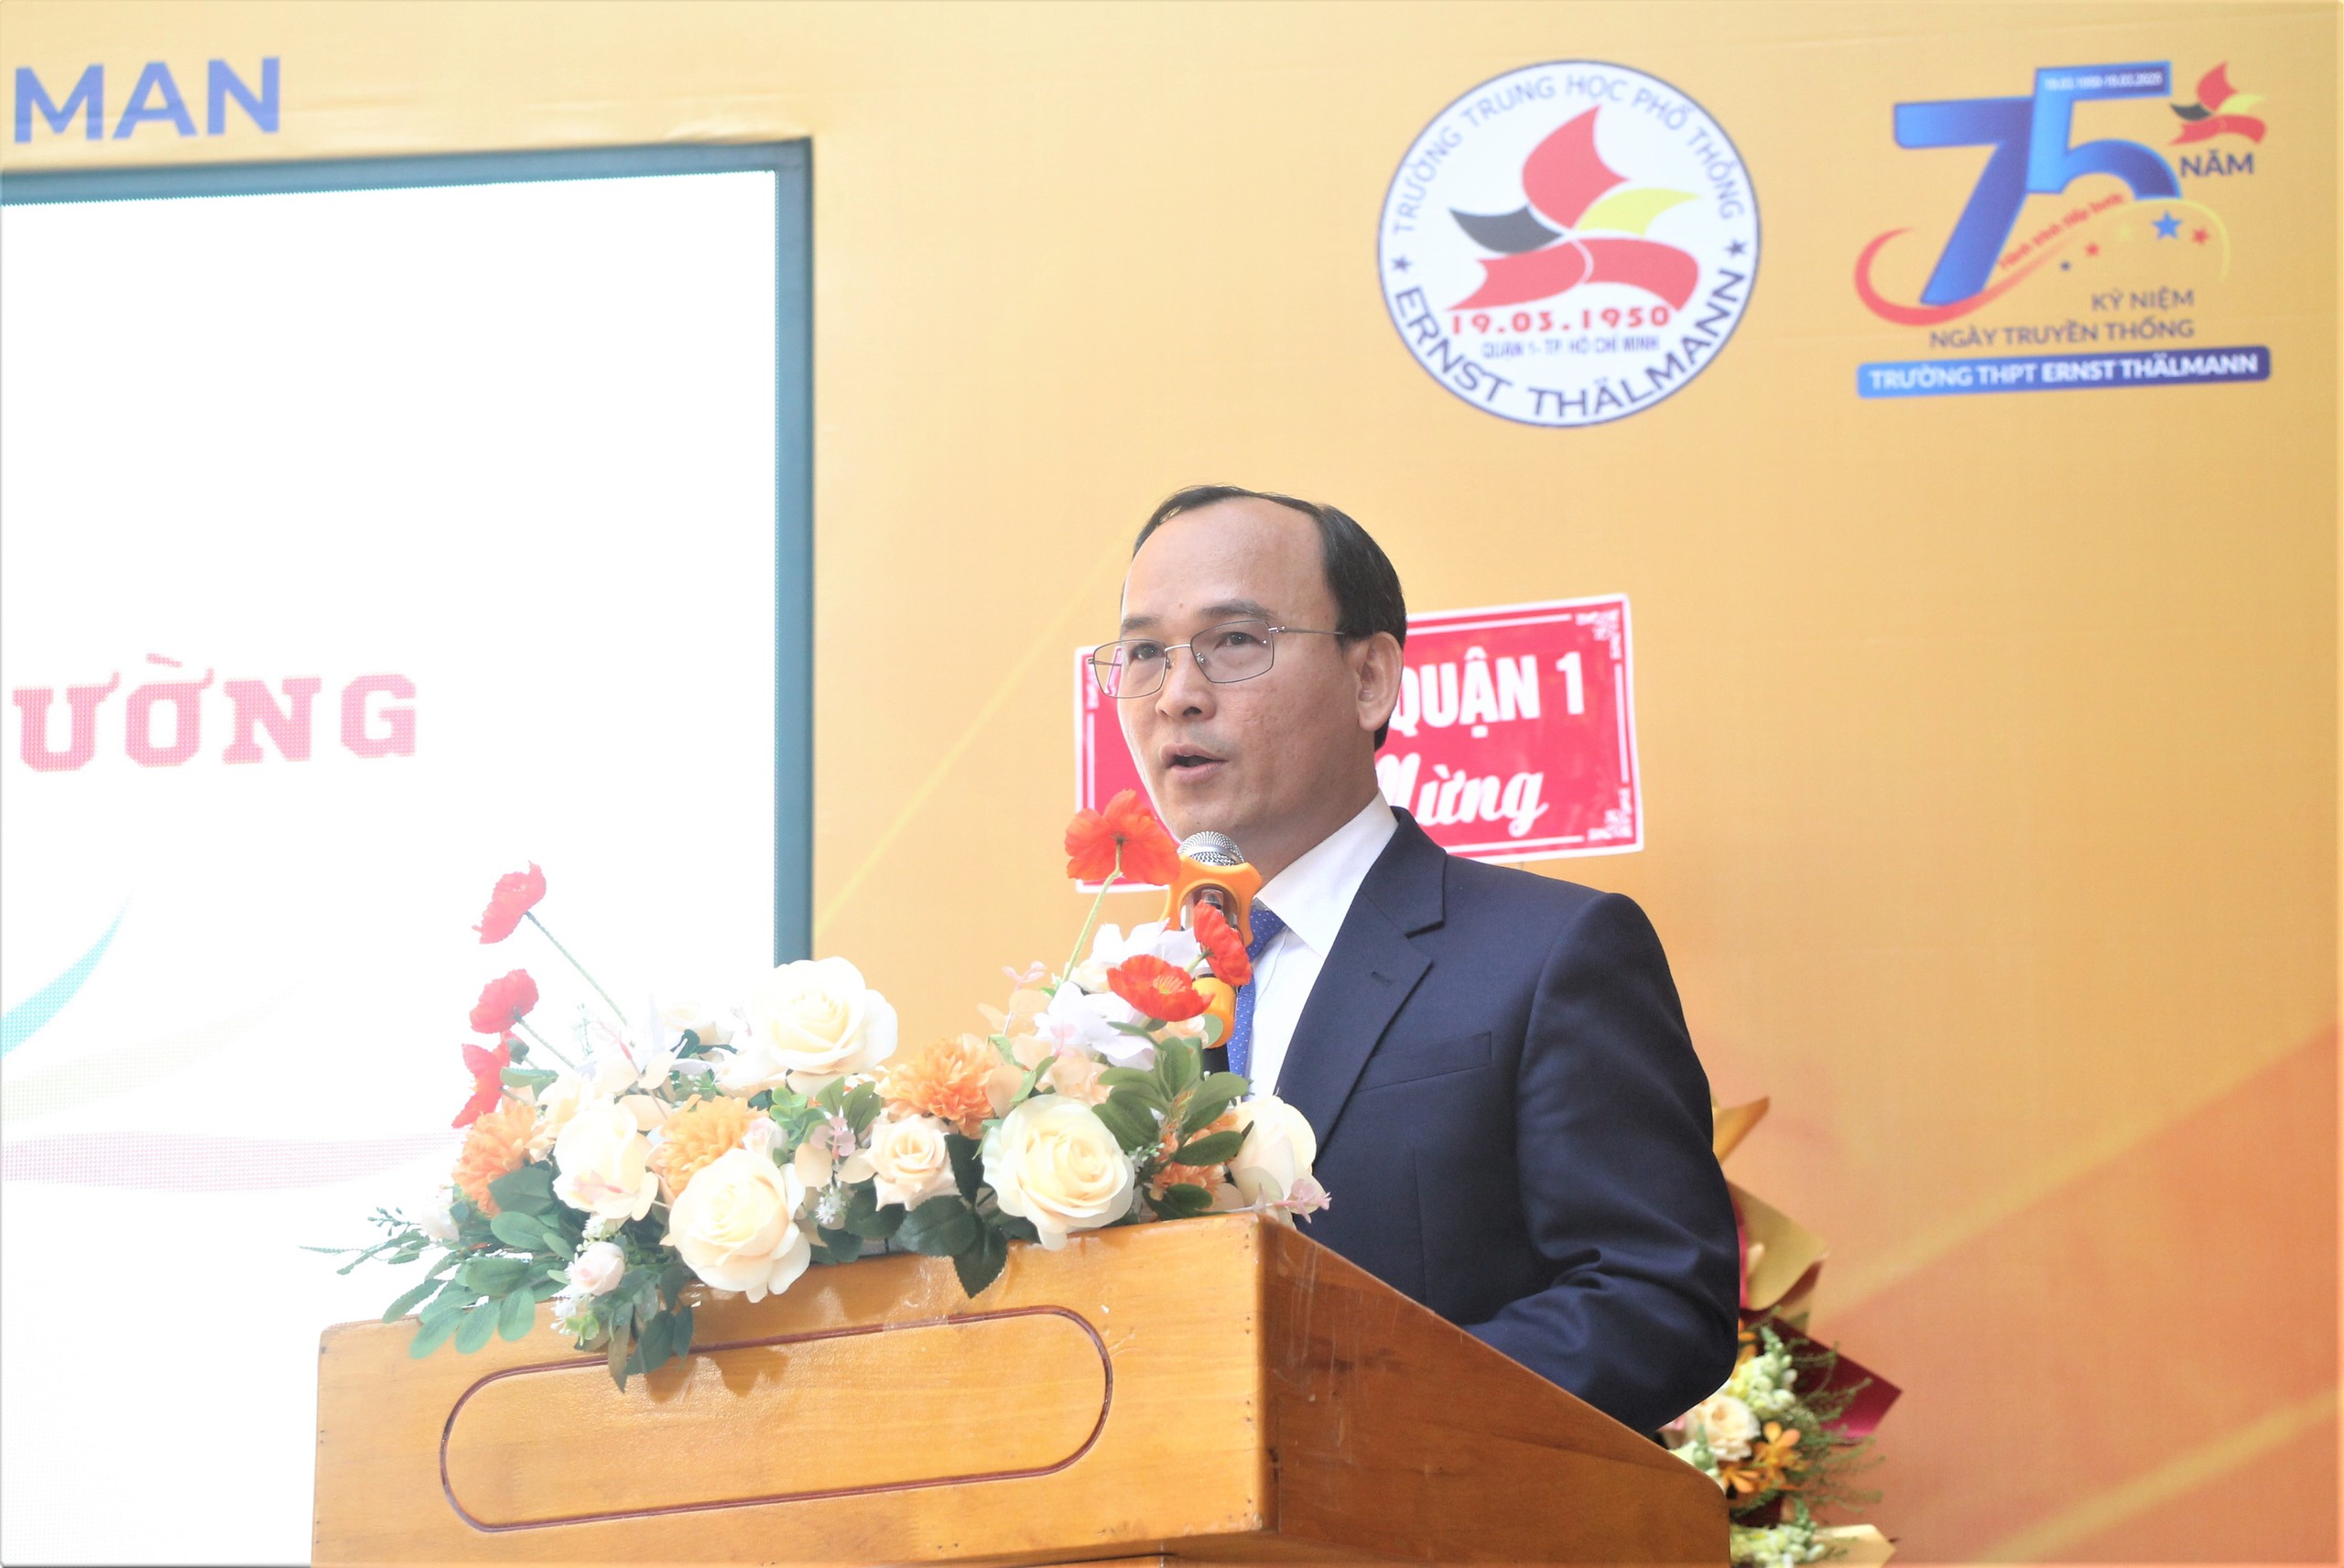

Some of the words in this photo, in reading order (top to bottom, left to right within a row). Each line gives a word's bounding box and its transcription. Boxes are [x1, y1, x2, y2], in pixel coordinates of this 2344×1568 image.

[1393, 124, 1465, 235] TRƯỜNG
[1460, 75, 1556, 129] TRUNG
[1566, 73, 1629, 103] HỌC
[2179, 149, 2255, 178] NĂM
[1893, 59, 2182, 306] 75
[2129, 287, 2196, 312] NIỆM
[1452, 305, 1672, 336] 19.03.1950
[1929, 326, 1997, 350] NGÀY
[2003, 319, 2099, 345] TRUYỀN
[2105, 314, 2196, 342] THỐNG
[1394, 286, 1514, 403] ERNST
[1527, 267, 1746, 418] THÄLMANN
[1869, 363, 1973, 391] TRƯỜNG
[1978, 364, 2036, 386] THPT
[2041, 360, 2112, 384] ERNST
[1388, 645, 1541, 740] QUẬN
[1556, 652, 1586, 716] 1
